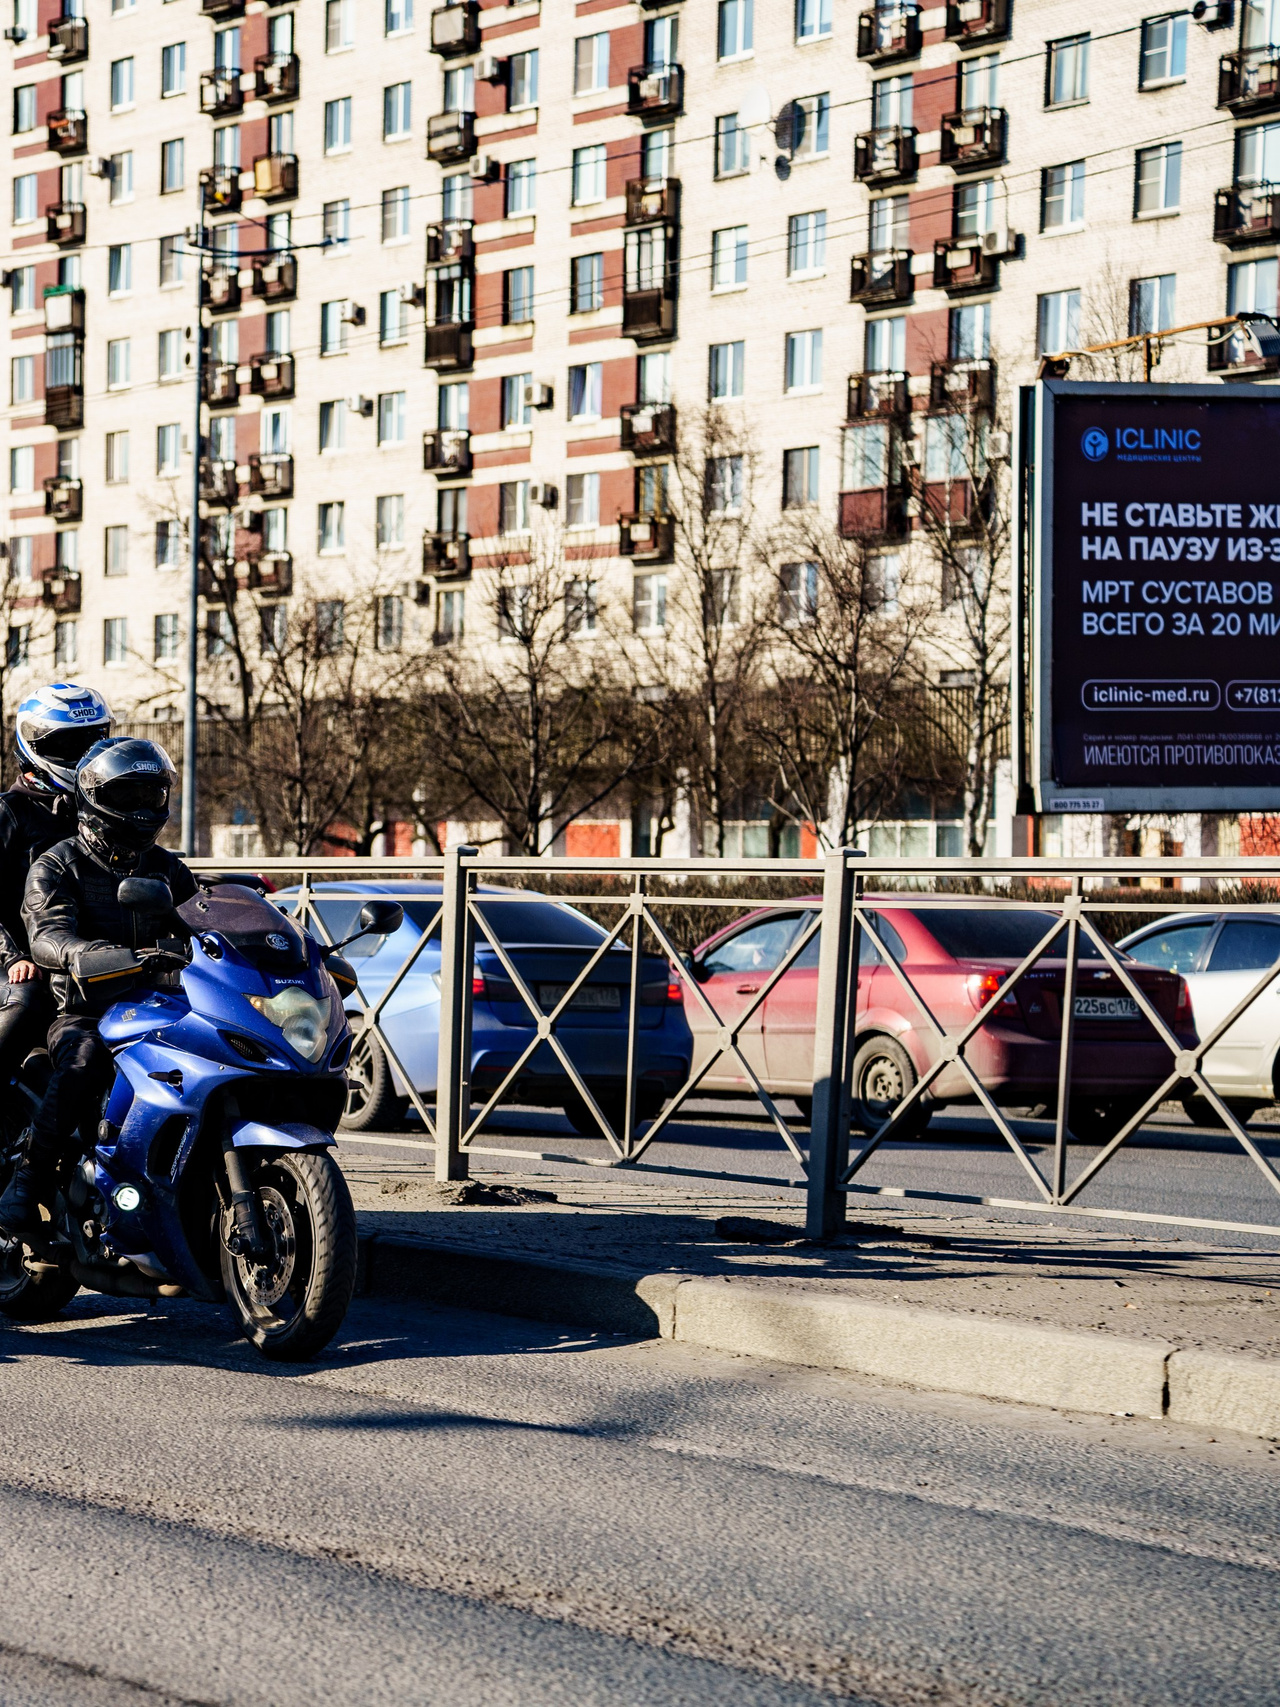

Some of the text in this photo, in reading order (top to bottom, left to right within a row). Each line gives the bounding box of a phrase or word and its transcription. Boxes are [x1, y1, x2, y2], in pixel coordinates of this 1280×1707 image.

[1116, 427, 1202, 450] ICLINIC
[1081, 502, 1280, 528] НЕ СТАВЬТЕ Ж
[1081, 536, 1123, 561] НА
[1129, 536, 1220, 562] ПАУЗУ
[1082, 580, 1274, 605] МРТ СУСТАВОВ
[1082, 612, 1165, 636] ВСЕГО
[1172, 612, 1205, 636] ЗА
[1211, 612, 1242, 636] 20
[1093, 686, 1210, 703] iclinic-med.ru
[71, 708, 96, 718] SHOEI
[1084, 745, 1160, 766] ИМЕЮТСЯ
[135, 763, 159, 773] SHOEI
